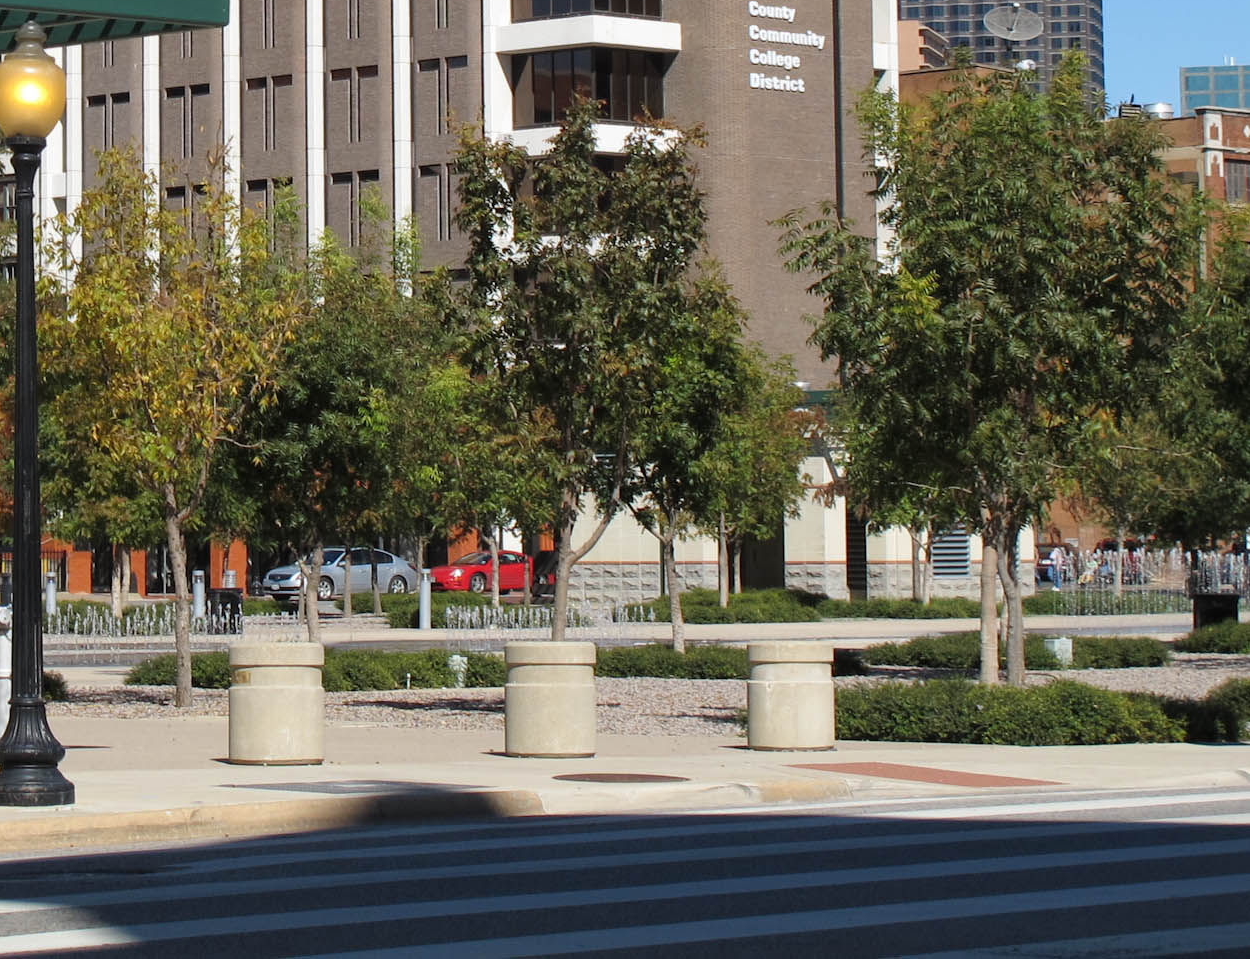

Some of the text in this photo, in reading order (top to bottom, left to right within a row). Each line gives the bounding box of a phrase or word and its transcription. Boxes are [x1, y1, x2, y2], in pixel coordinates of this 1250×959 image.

[748, 1, 796, 22] County
[749, 25, 826, 49] Community
[750, 49, 801, 69] College
[750, 73, 805, 92] District
